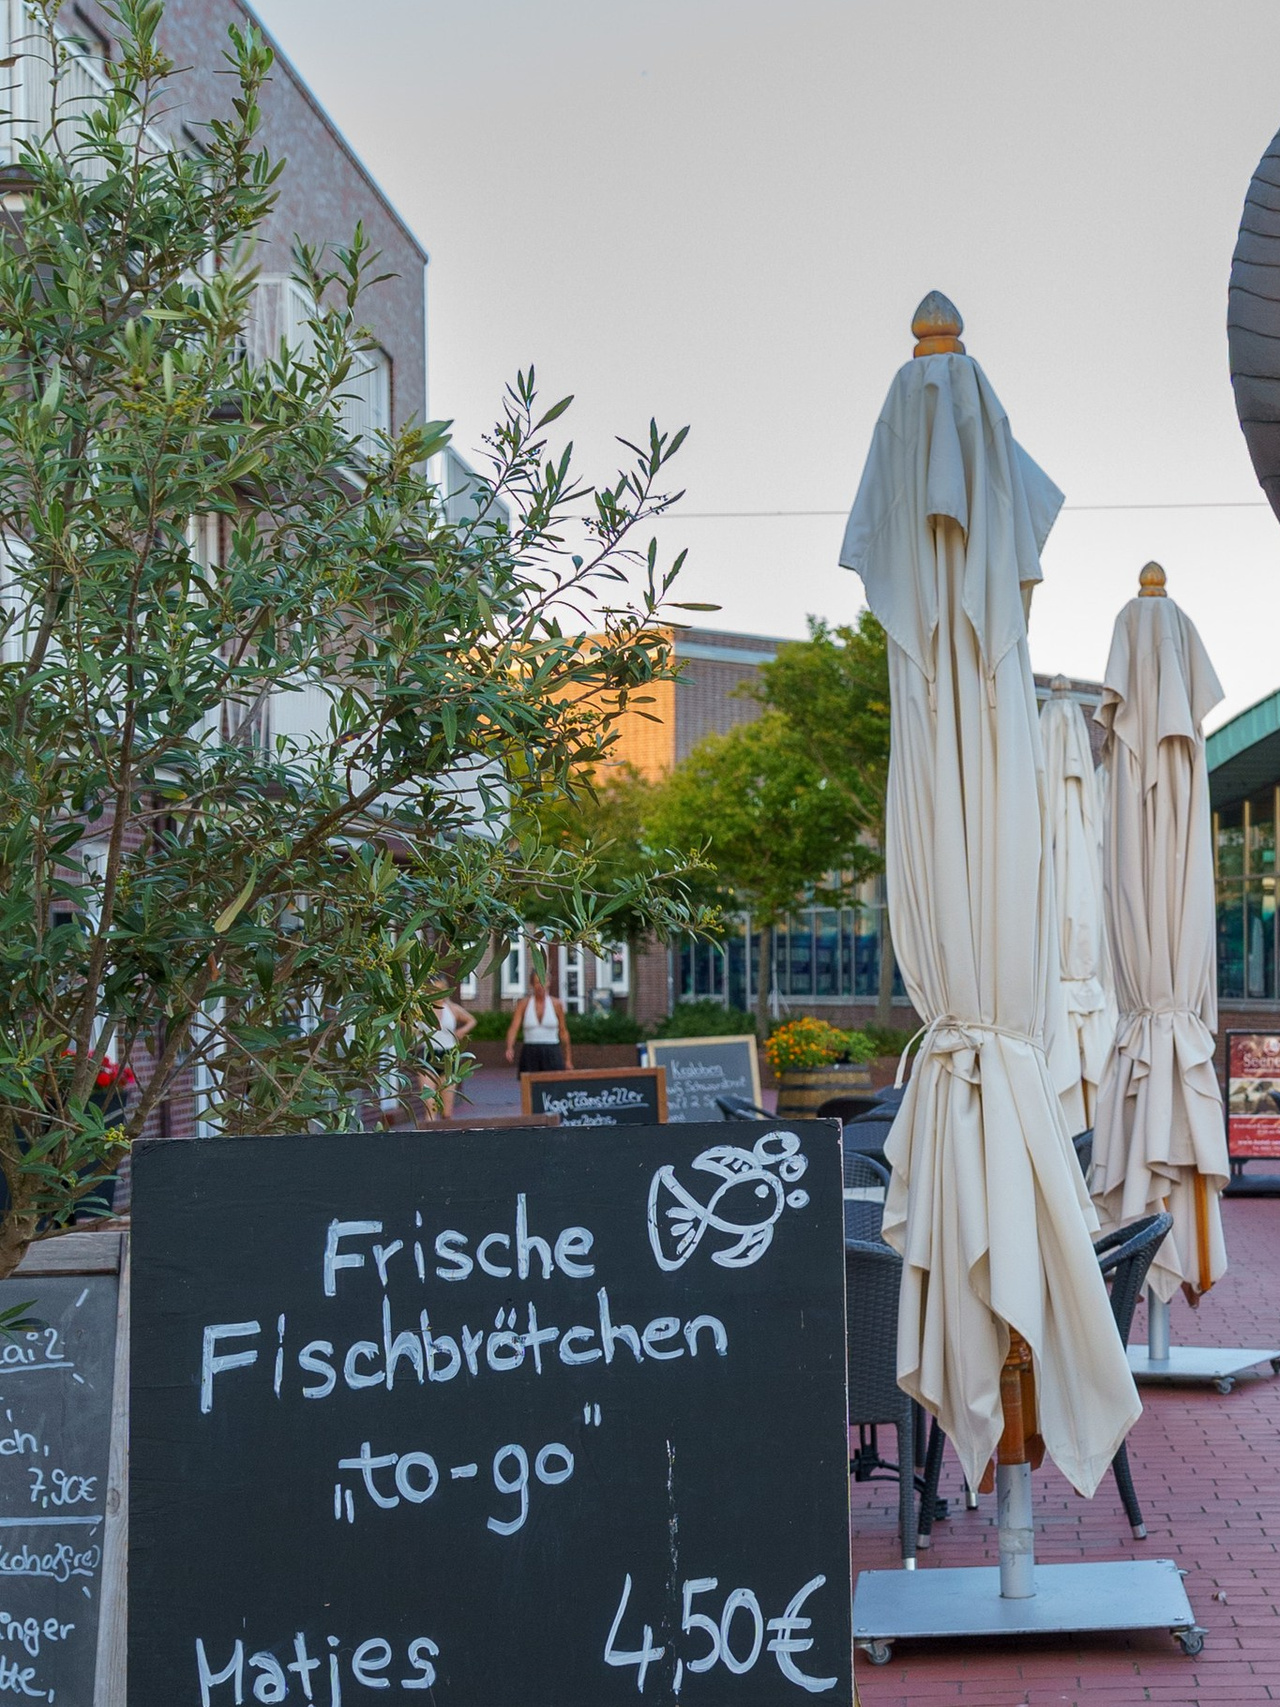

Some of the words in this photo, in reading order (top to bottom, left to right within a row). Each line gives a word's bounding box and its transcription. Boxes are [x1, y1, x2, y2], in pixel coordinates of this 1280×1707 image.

[323, 1193, 596, 1297] Frische
[200, 1286, 728, 1414] Fischbrötchen
[27, 1466, 98, 1509] 7,90€
[196, 1632, 440, 1707] Matjes
[604, 1573, 838, 1695] 4,50€
